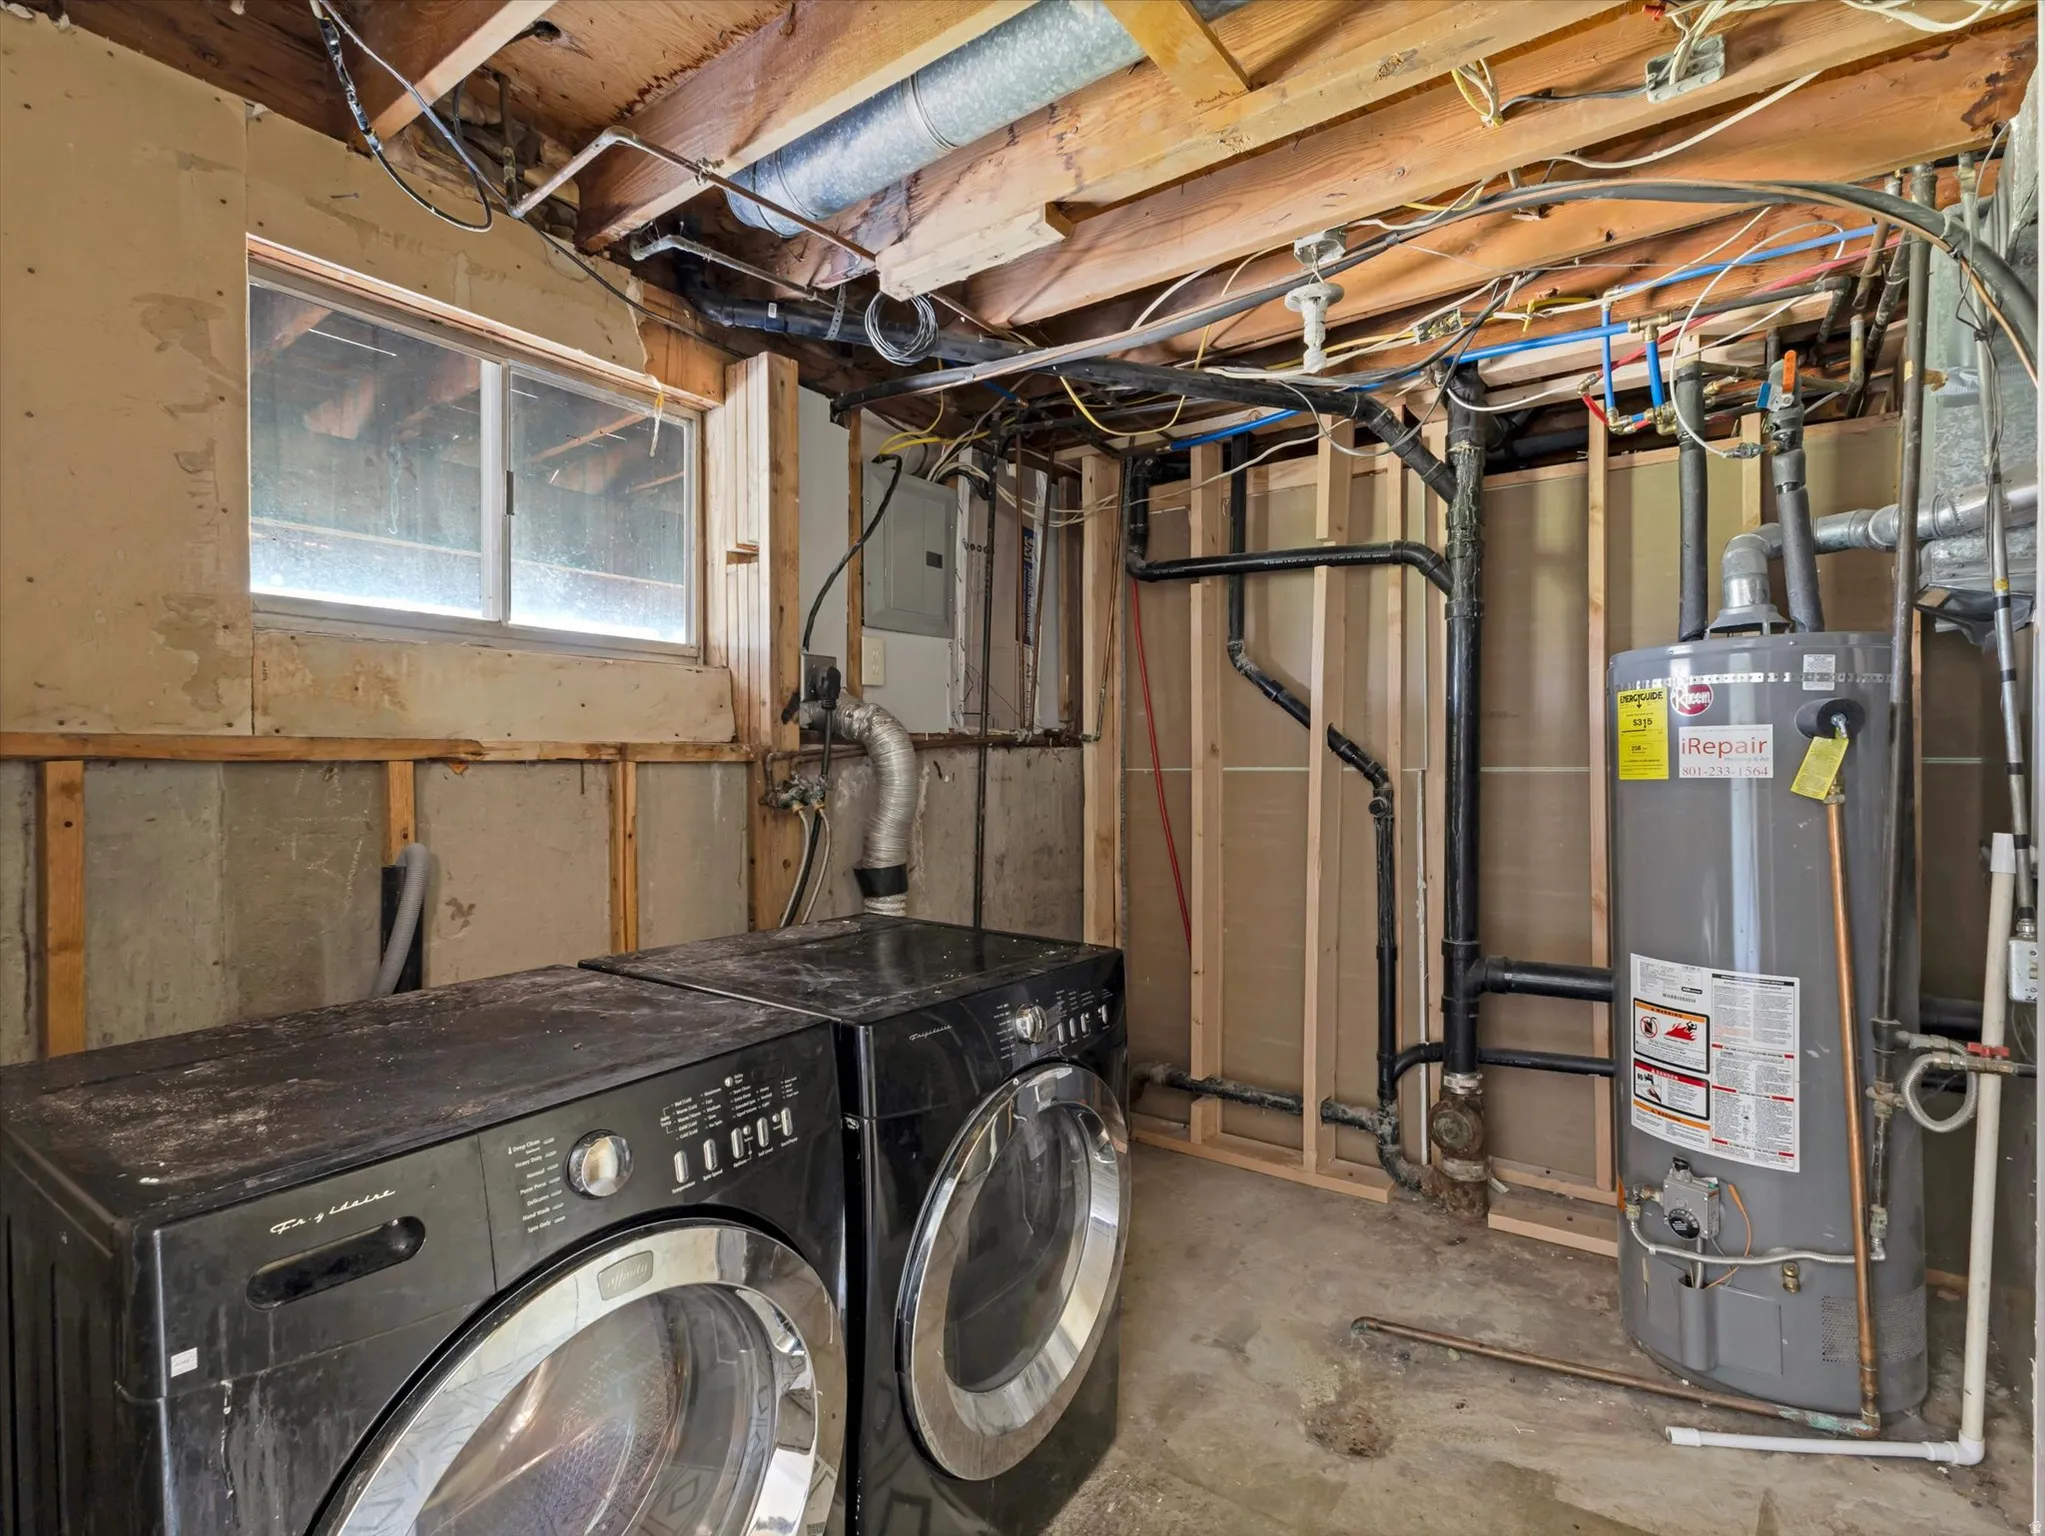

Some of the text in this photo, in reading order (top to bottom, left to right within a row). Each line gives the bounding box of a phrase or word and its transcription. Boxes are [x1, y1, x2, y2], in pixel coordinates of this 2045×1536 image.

[1632, 718, 1653, 727] $315
[1682, 737, 1768, 758] iRepair
[1682, 766, 1768, 777] 801-233-1564
[513, 1144, 527, 1153] Deep
[526, 1139, 541, 1148] Clean
[515, 1155, 543, 1169] Heavy Duty
[527, 1167, 545, 1179] Normal
[527, 1194, 550, 1207] Delicates
[269, 1189, 396, 1236] Frigidaire
[522, 1212, 537, 1221] Hand
[527, 1220, 552, 1234] Spin Only
